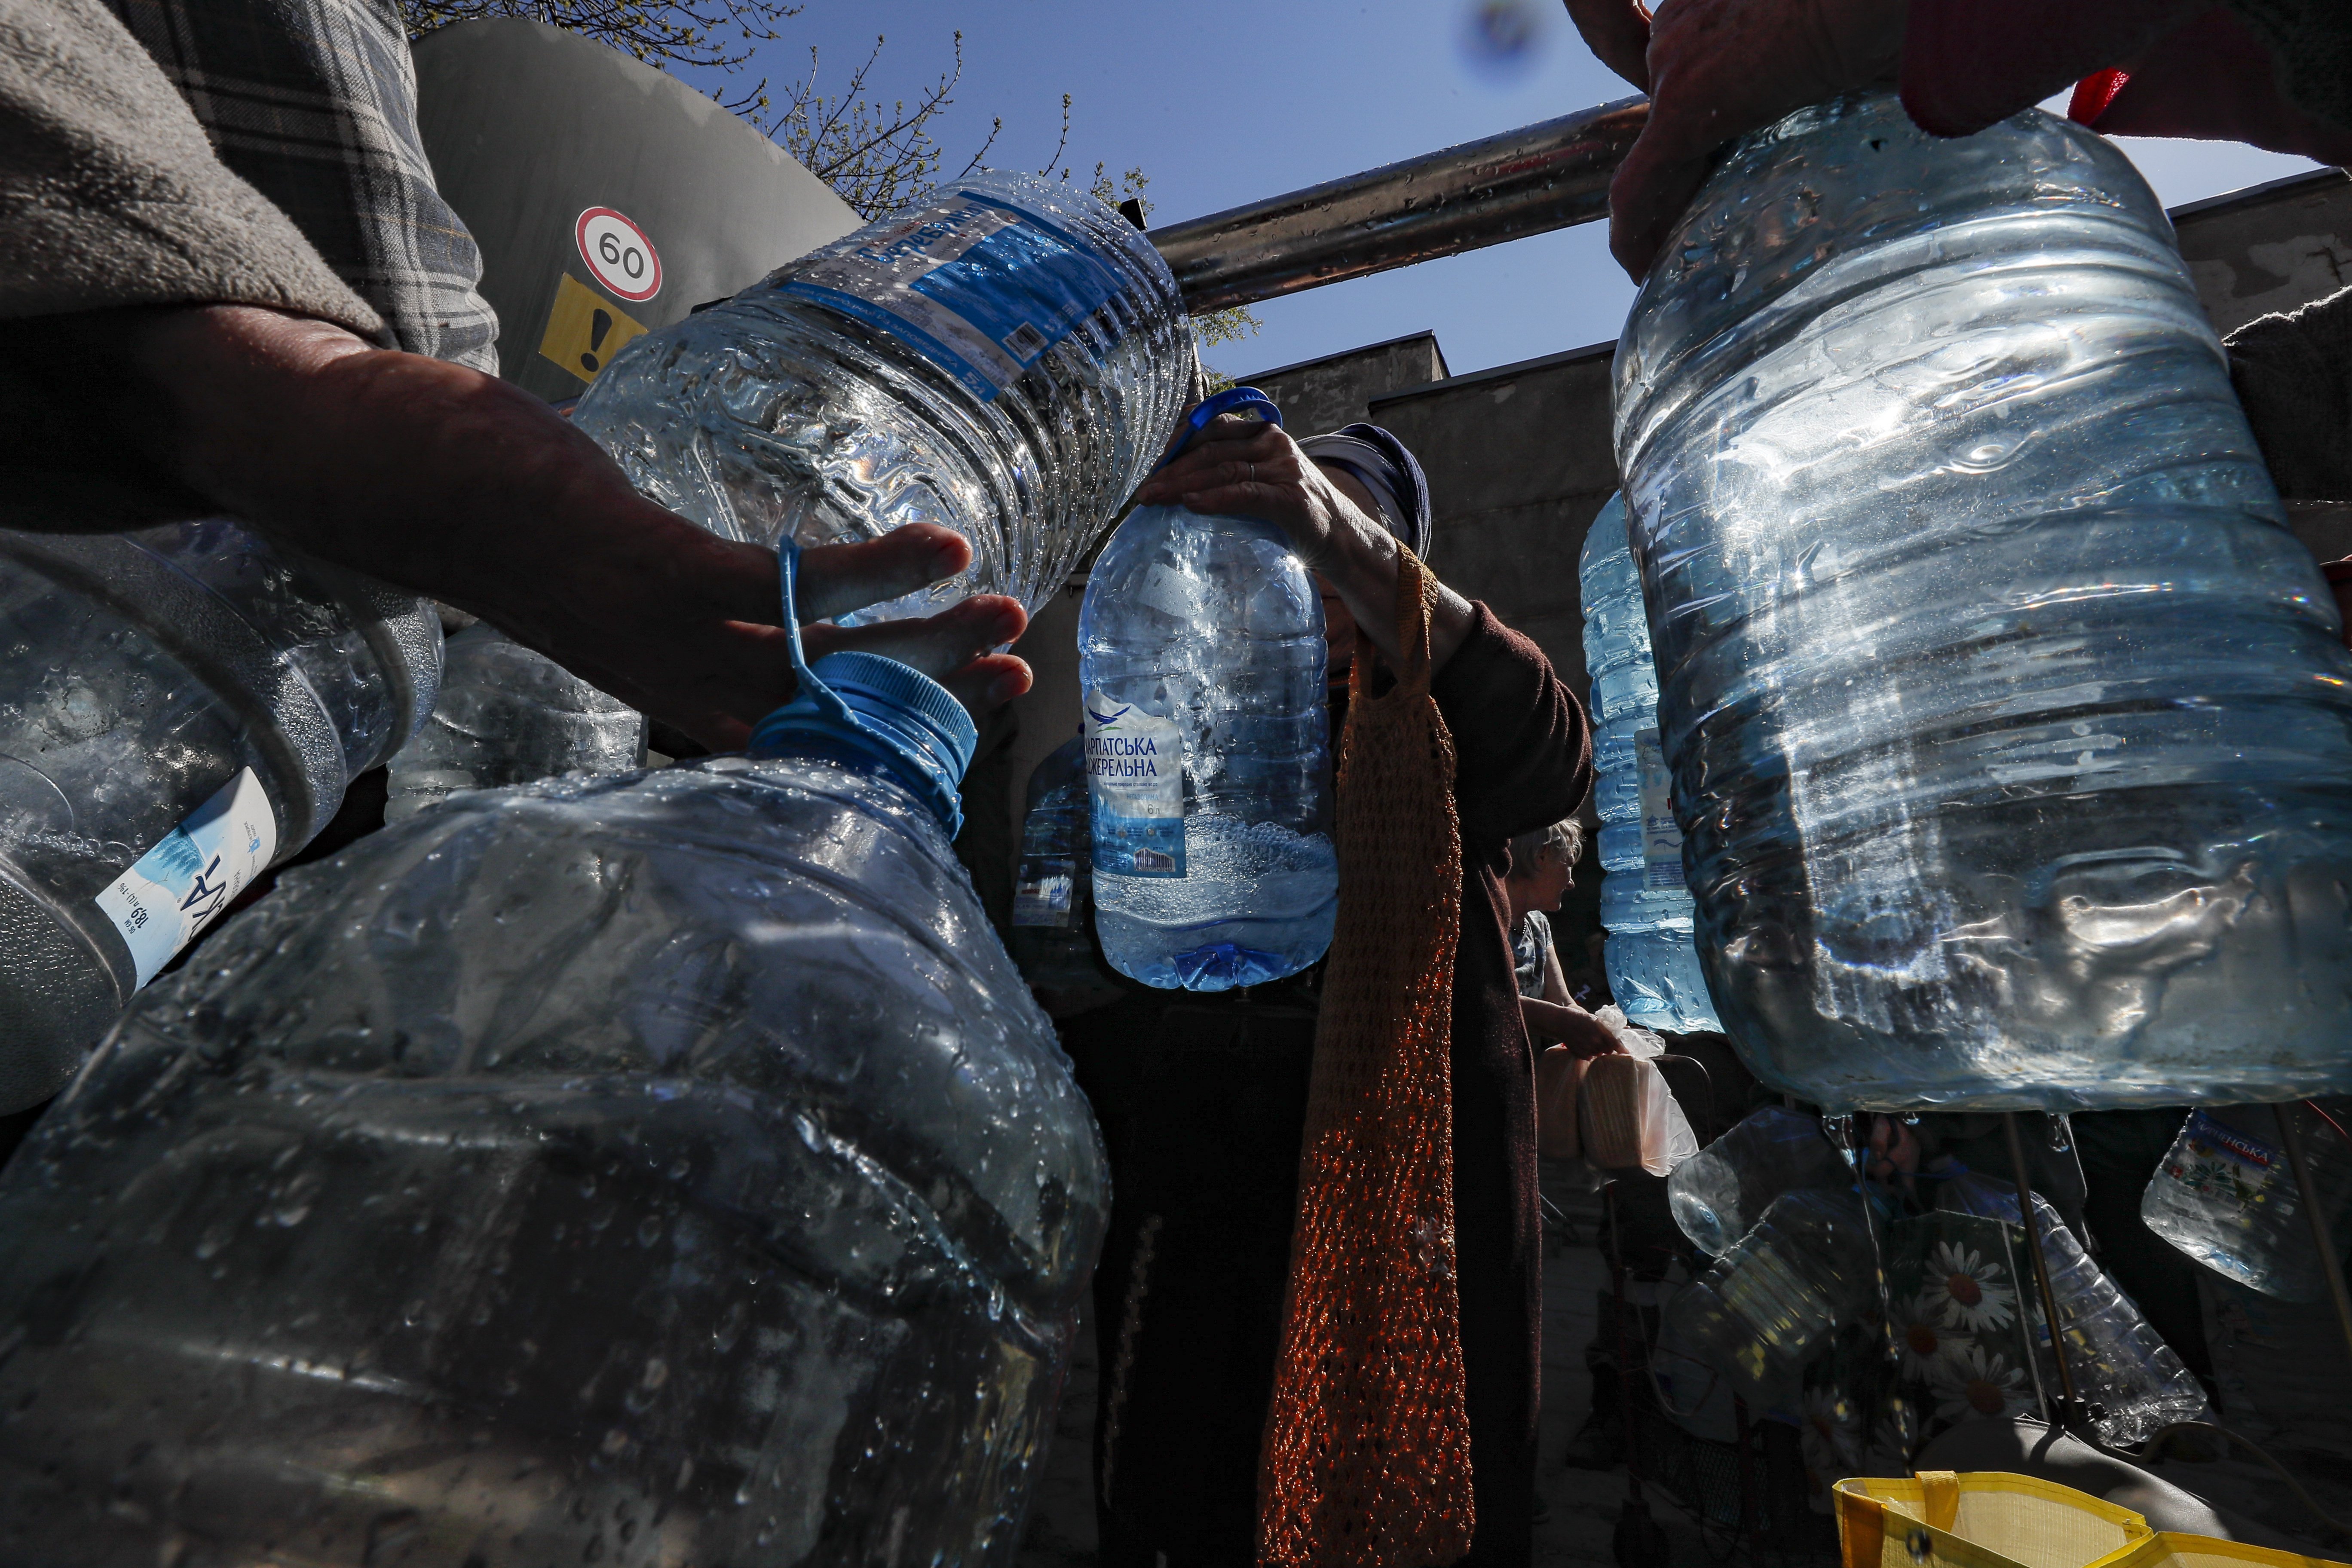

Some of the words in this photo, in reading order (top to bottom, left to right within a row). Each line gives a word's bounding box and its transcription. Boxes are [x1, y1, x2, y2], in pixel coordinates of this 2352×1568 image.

[599, 232, 644, 279] 60
[891, 324, 957, 368] ЗАПОВЕДНИКА
[1148, 804, 1154, 814] 6
[131, 907, 149, 929] 18,9
